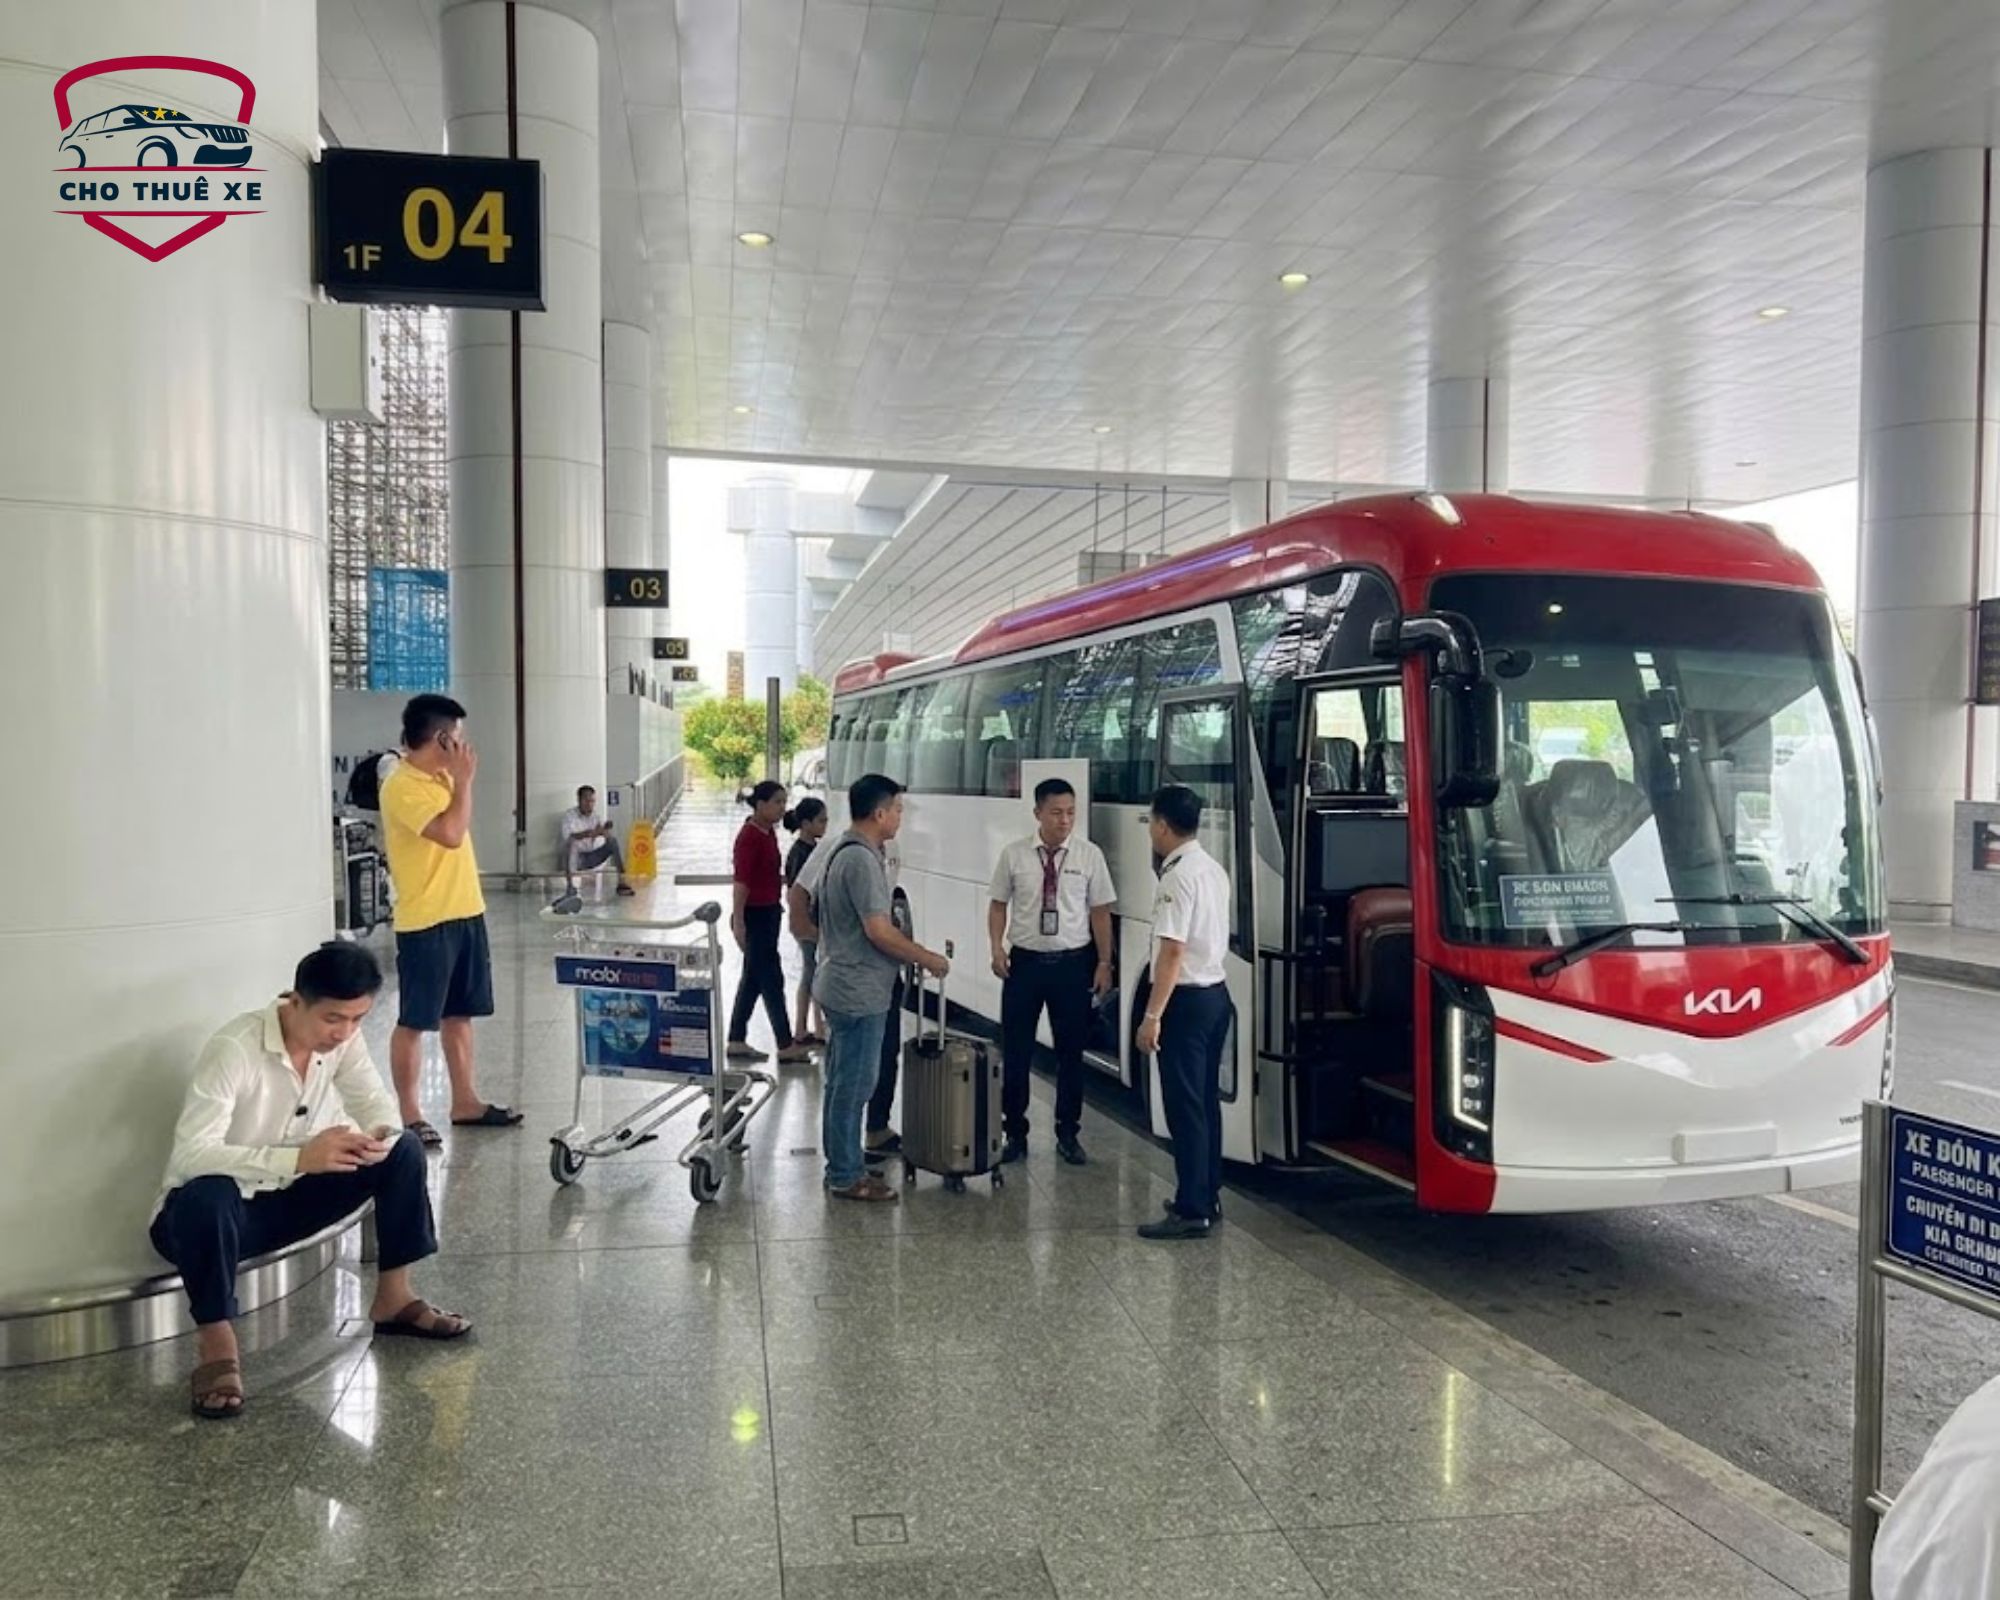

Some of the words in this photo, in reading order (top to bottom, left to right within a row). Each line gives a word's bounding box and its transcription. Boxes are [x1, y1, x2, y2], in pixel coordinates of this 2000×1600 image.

[343, 244, 382, 271] 1F
[403, 186, 513, 264] 04
[630, 577, 662, 599] 03
[1684, 987, 1762, 1015] KIA
[1905, 1129, 1932, 1158] XE
